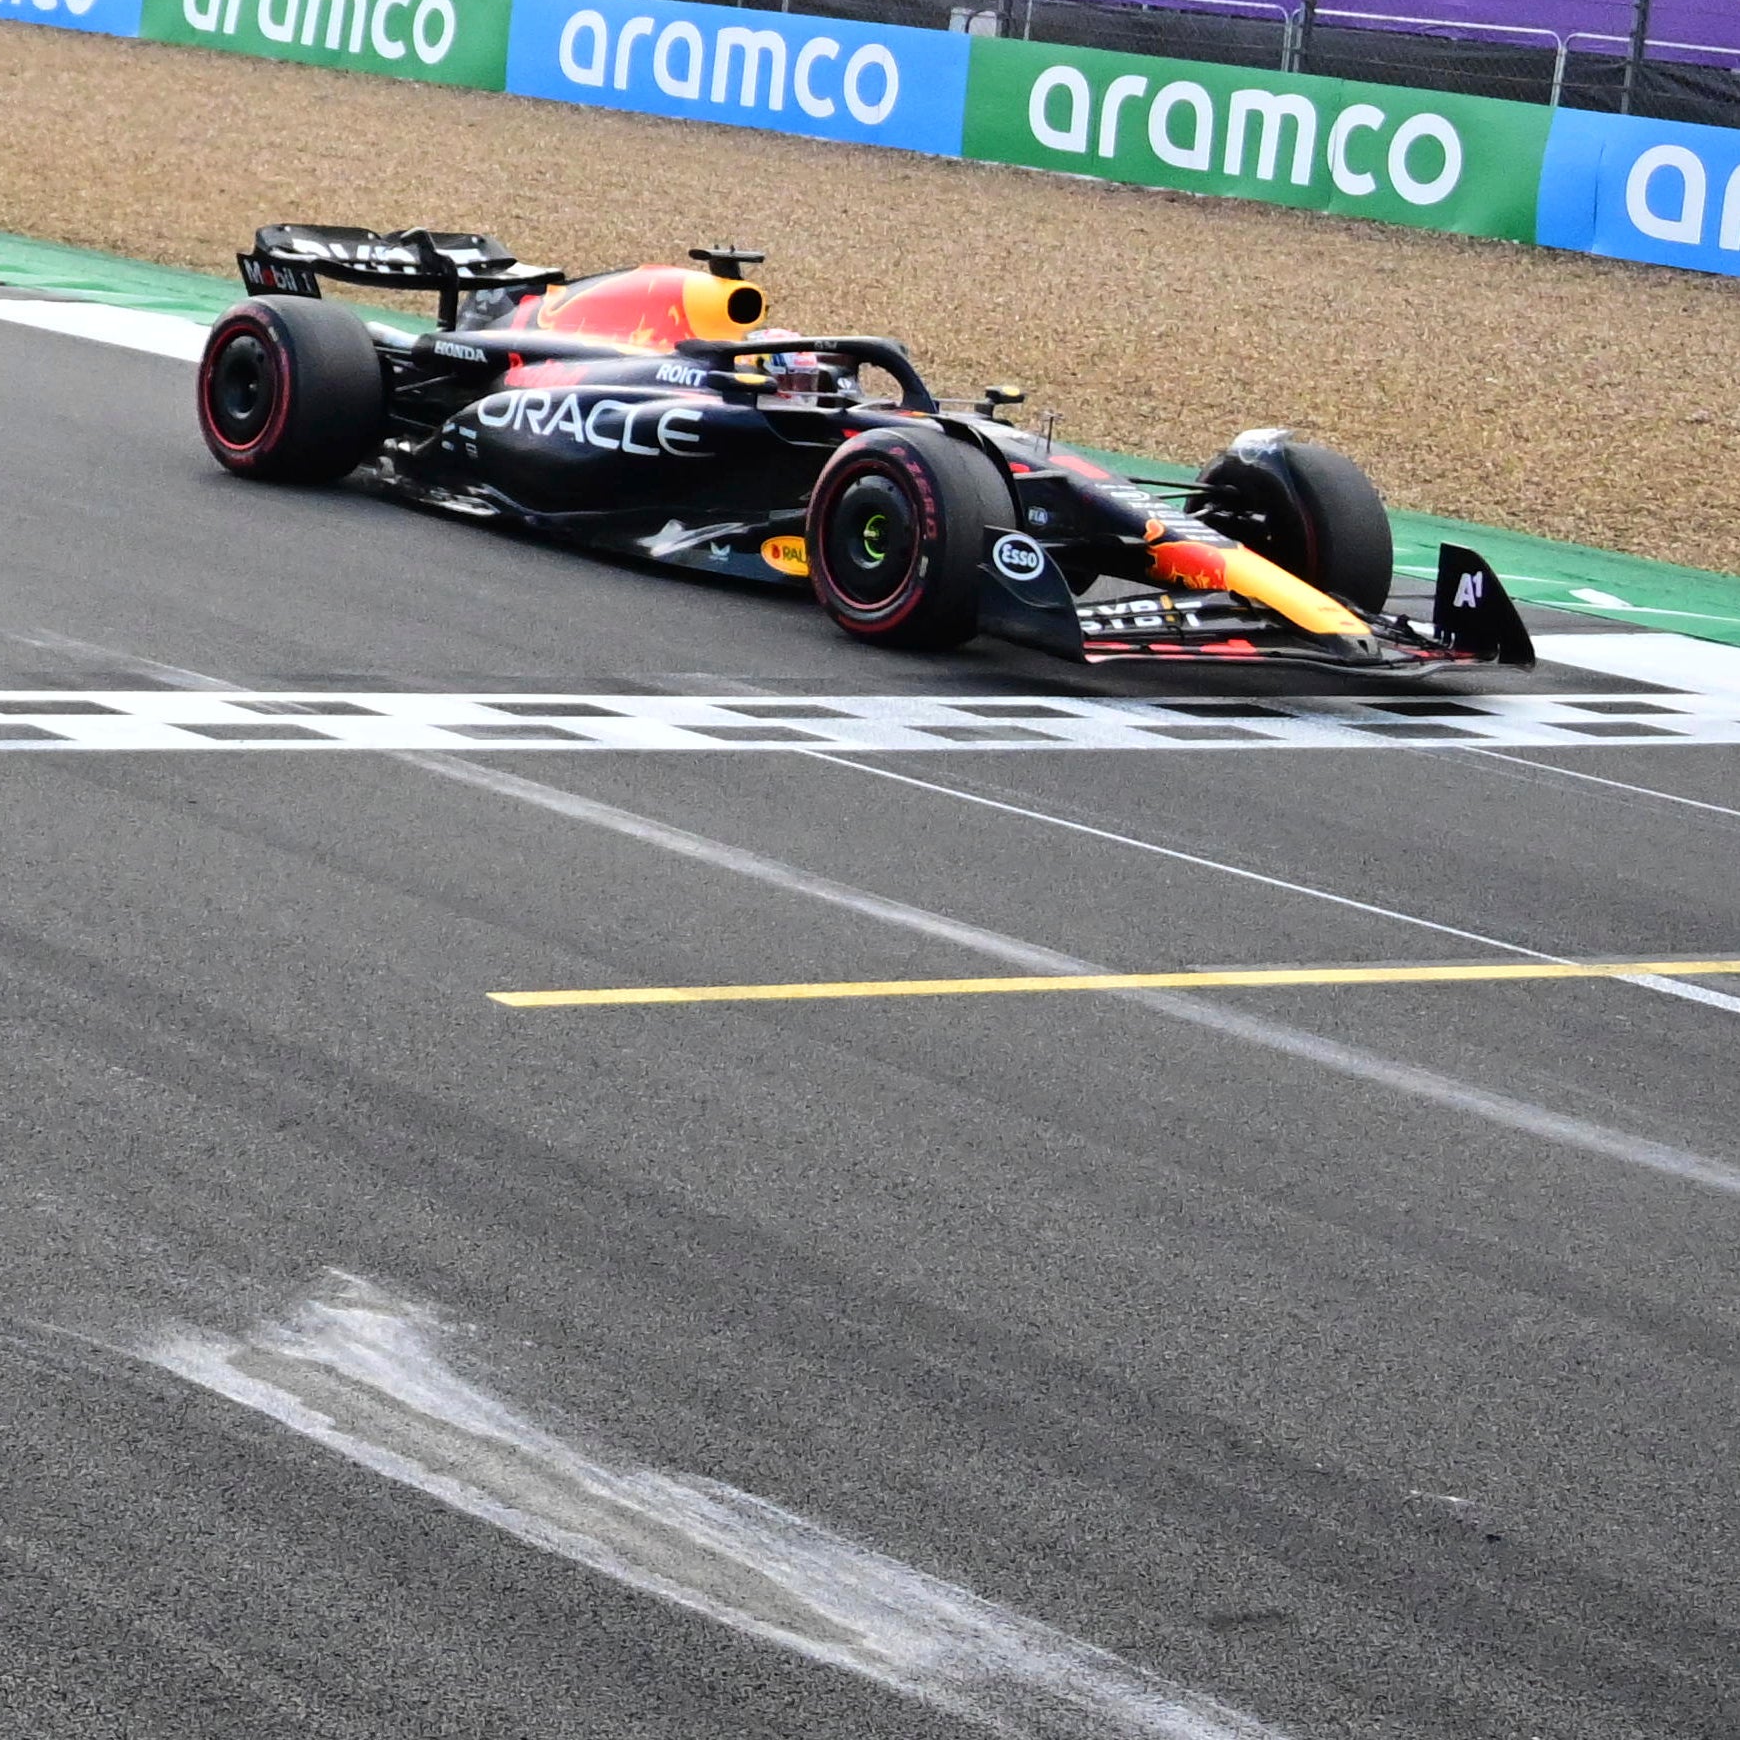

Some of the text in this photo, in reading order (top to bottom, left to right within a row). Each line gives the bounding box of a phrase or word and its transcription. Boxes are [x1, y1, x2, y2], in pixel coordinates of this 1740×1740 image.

[559, 9, 899, 125] aramco
[1028, 64, 1463, 206] aramco
[244, 258, 313, 292] Mobil 1
[433, 340, 487, 364] HONDA
[656, 364, 708, 388] ROKT
[477, 390, 717, 458] ORACLE
[1028, 509, 1048, 526] FIA
[1001, 543, 1038, 569] Esso
[1452, 571, 1484, 608] A1
